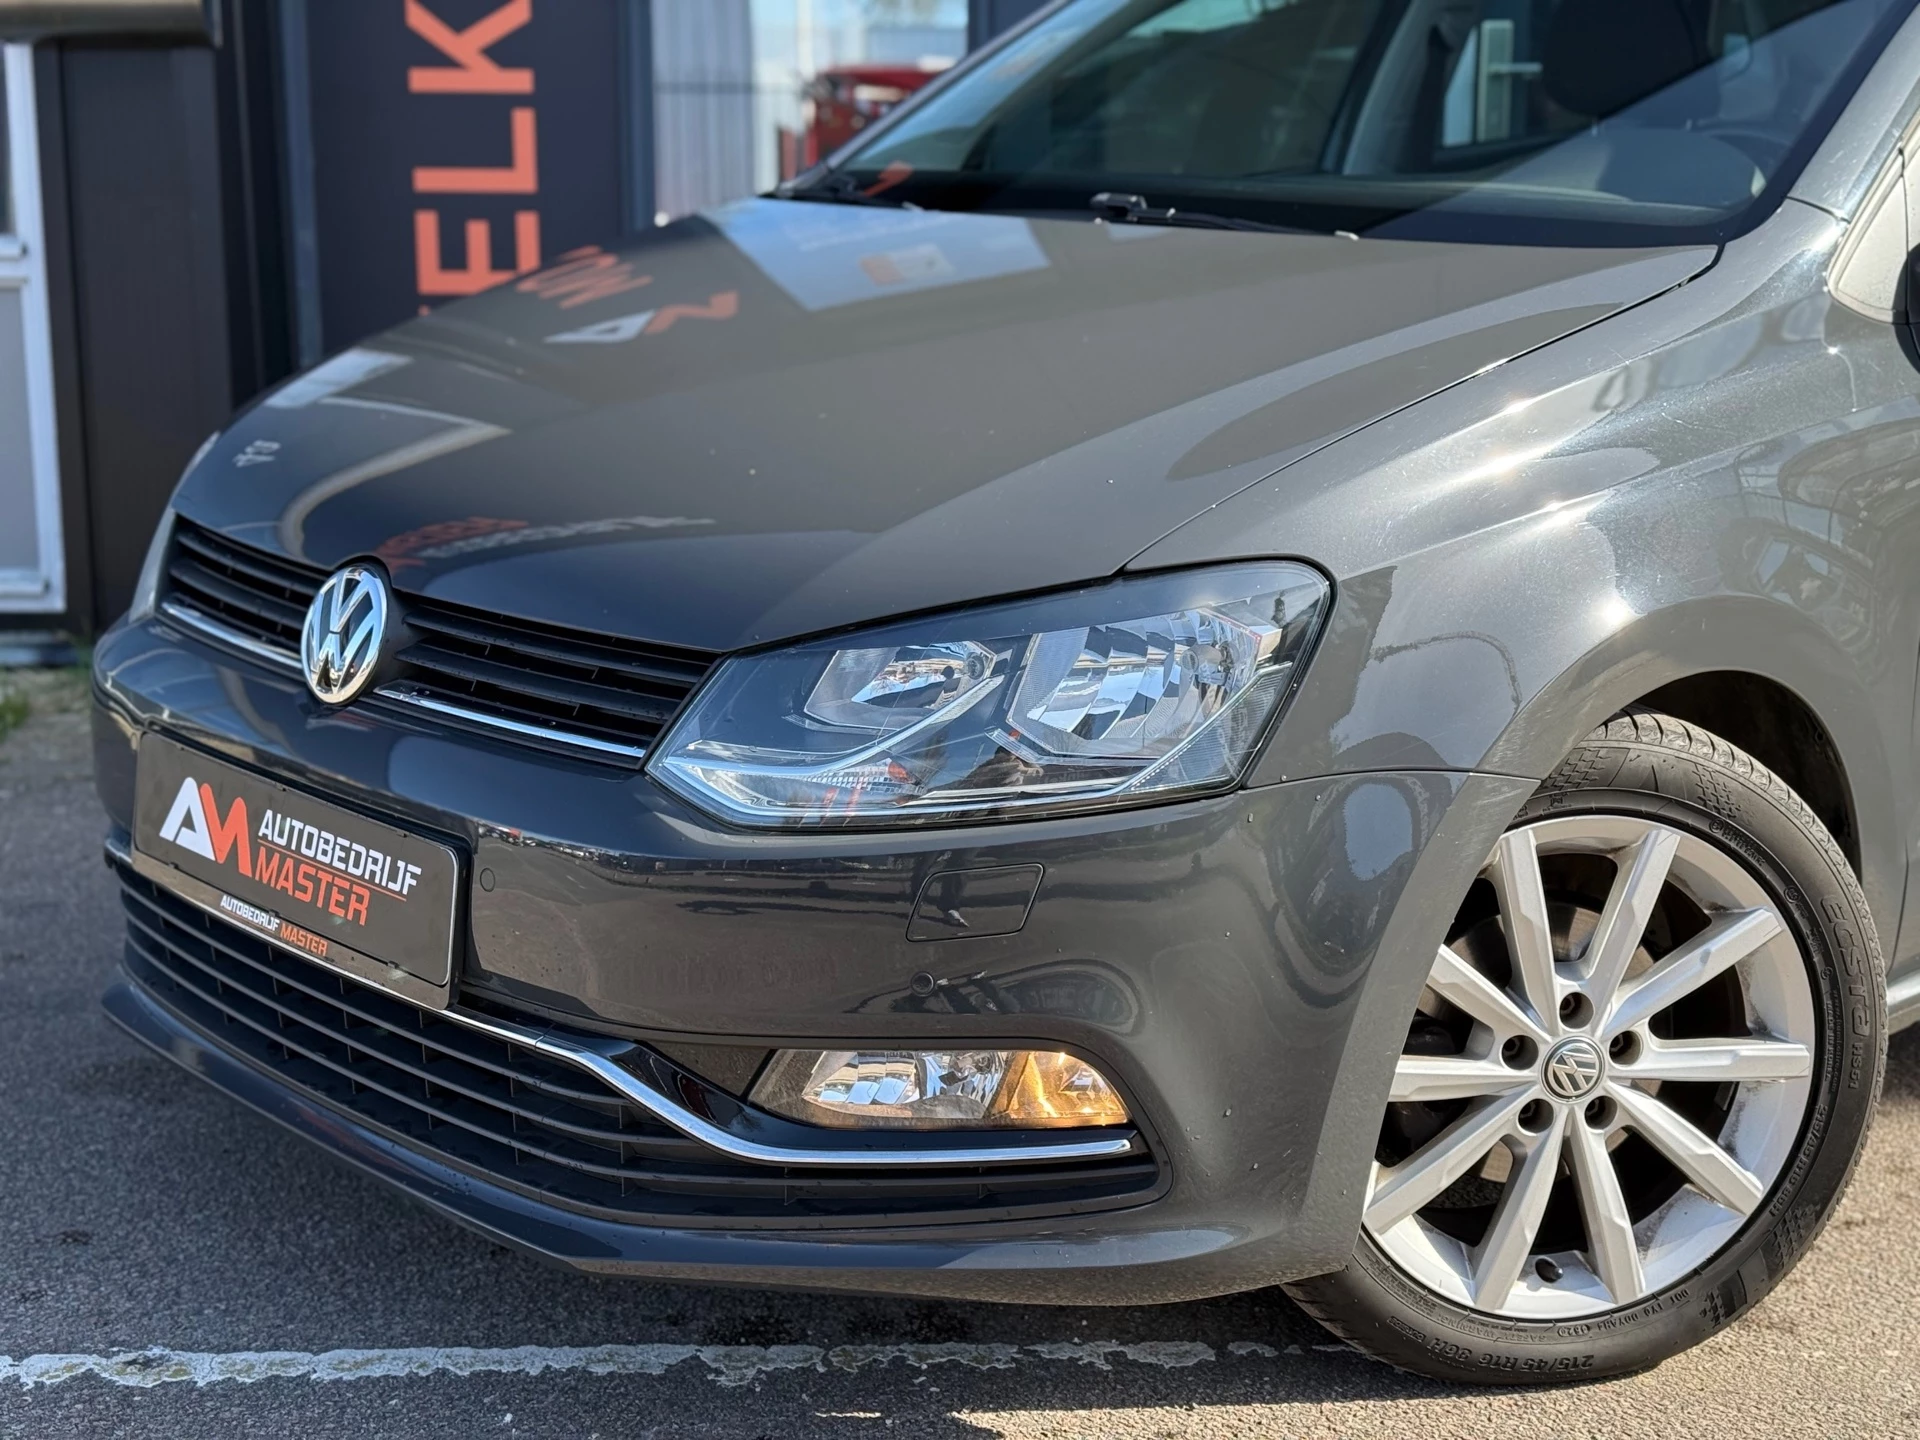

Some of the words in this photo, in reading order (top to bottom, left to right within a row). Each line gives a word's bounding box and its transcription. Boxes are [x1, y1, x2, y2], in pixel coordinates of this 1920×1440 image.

[405, 0, 541, 316] ELK
[159, 777, 252, 878] AM
[258, 809, 422, 895] AUTOBEDRIJF
[220, 895, 281, 932] AUTOBEDRIJF
[255, 847, 370, 926] MASTER
[280, 922, 328, 956] MASTER
[1519, 1353, 1595, 1373] 215/45
